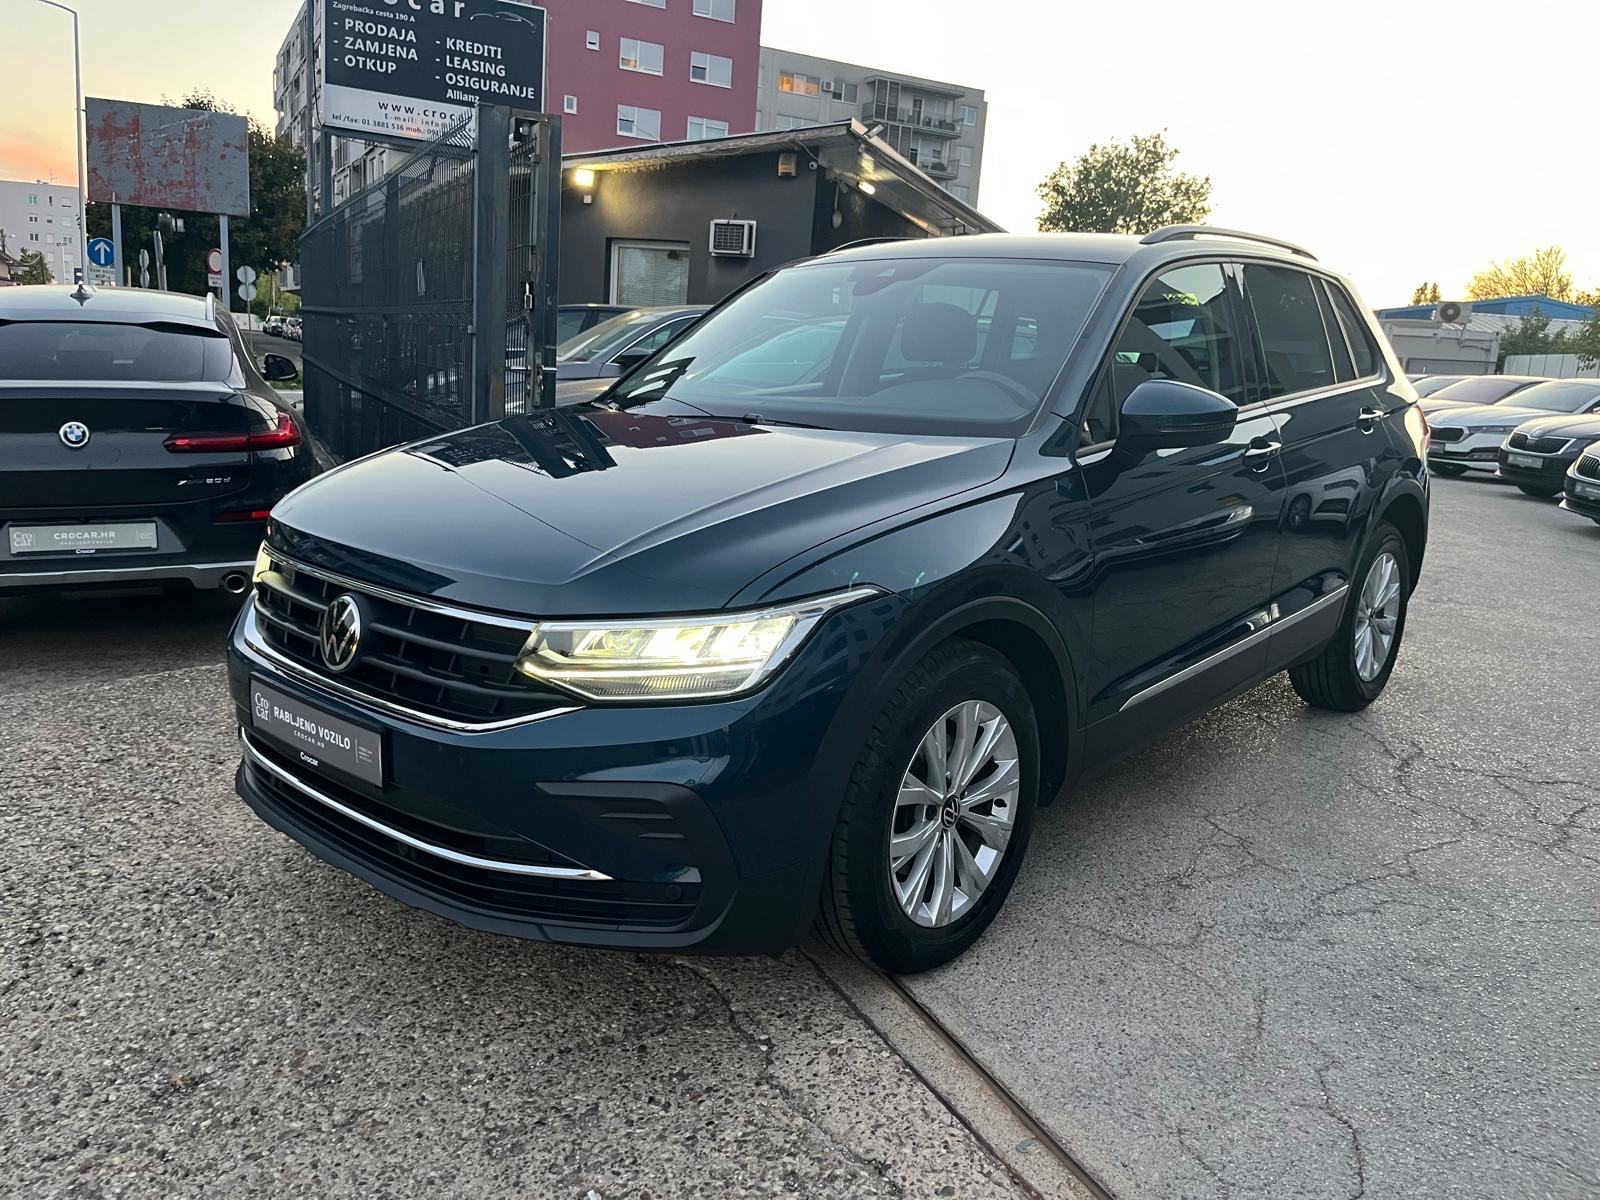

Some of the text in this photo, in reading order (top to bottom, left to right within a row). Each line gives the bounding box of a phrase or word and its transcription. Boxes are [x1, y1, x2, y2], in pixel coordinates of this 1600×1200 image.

[375, 10, 394, 18] cesta
[395, 12, 408, 21] 190
[344, 18, 417, 43] PRODAJA
[344, 36, 418, 61] ZAMJENA
[446, 37, 502, 59] KREDITI
[344, 54, 397, 74] OTKUP
[446, 55, 506, 77] LEASING
[445, 72, 535, 99] OSIGURANJE
[446, 89, 479, 103] Allianz
[361, 118, 370, 126] 01
[54, 531, 116, 540] CROCAR.HR
[255, 692, 269, 709] Cro
[273, 706, 351, 750] RABLJENO VOZILO
[300, 751, 319, 767] Crocar
